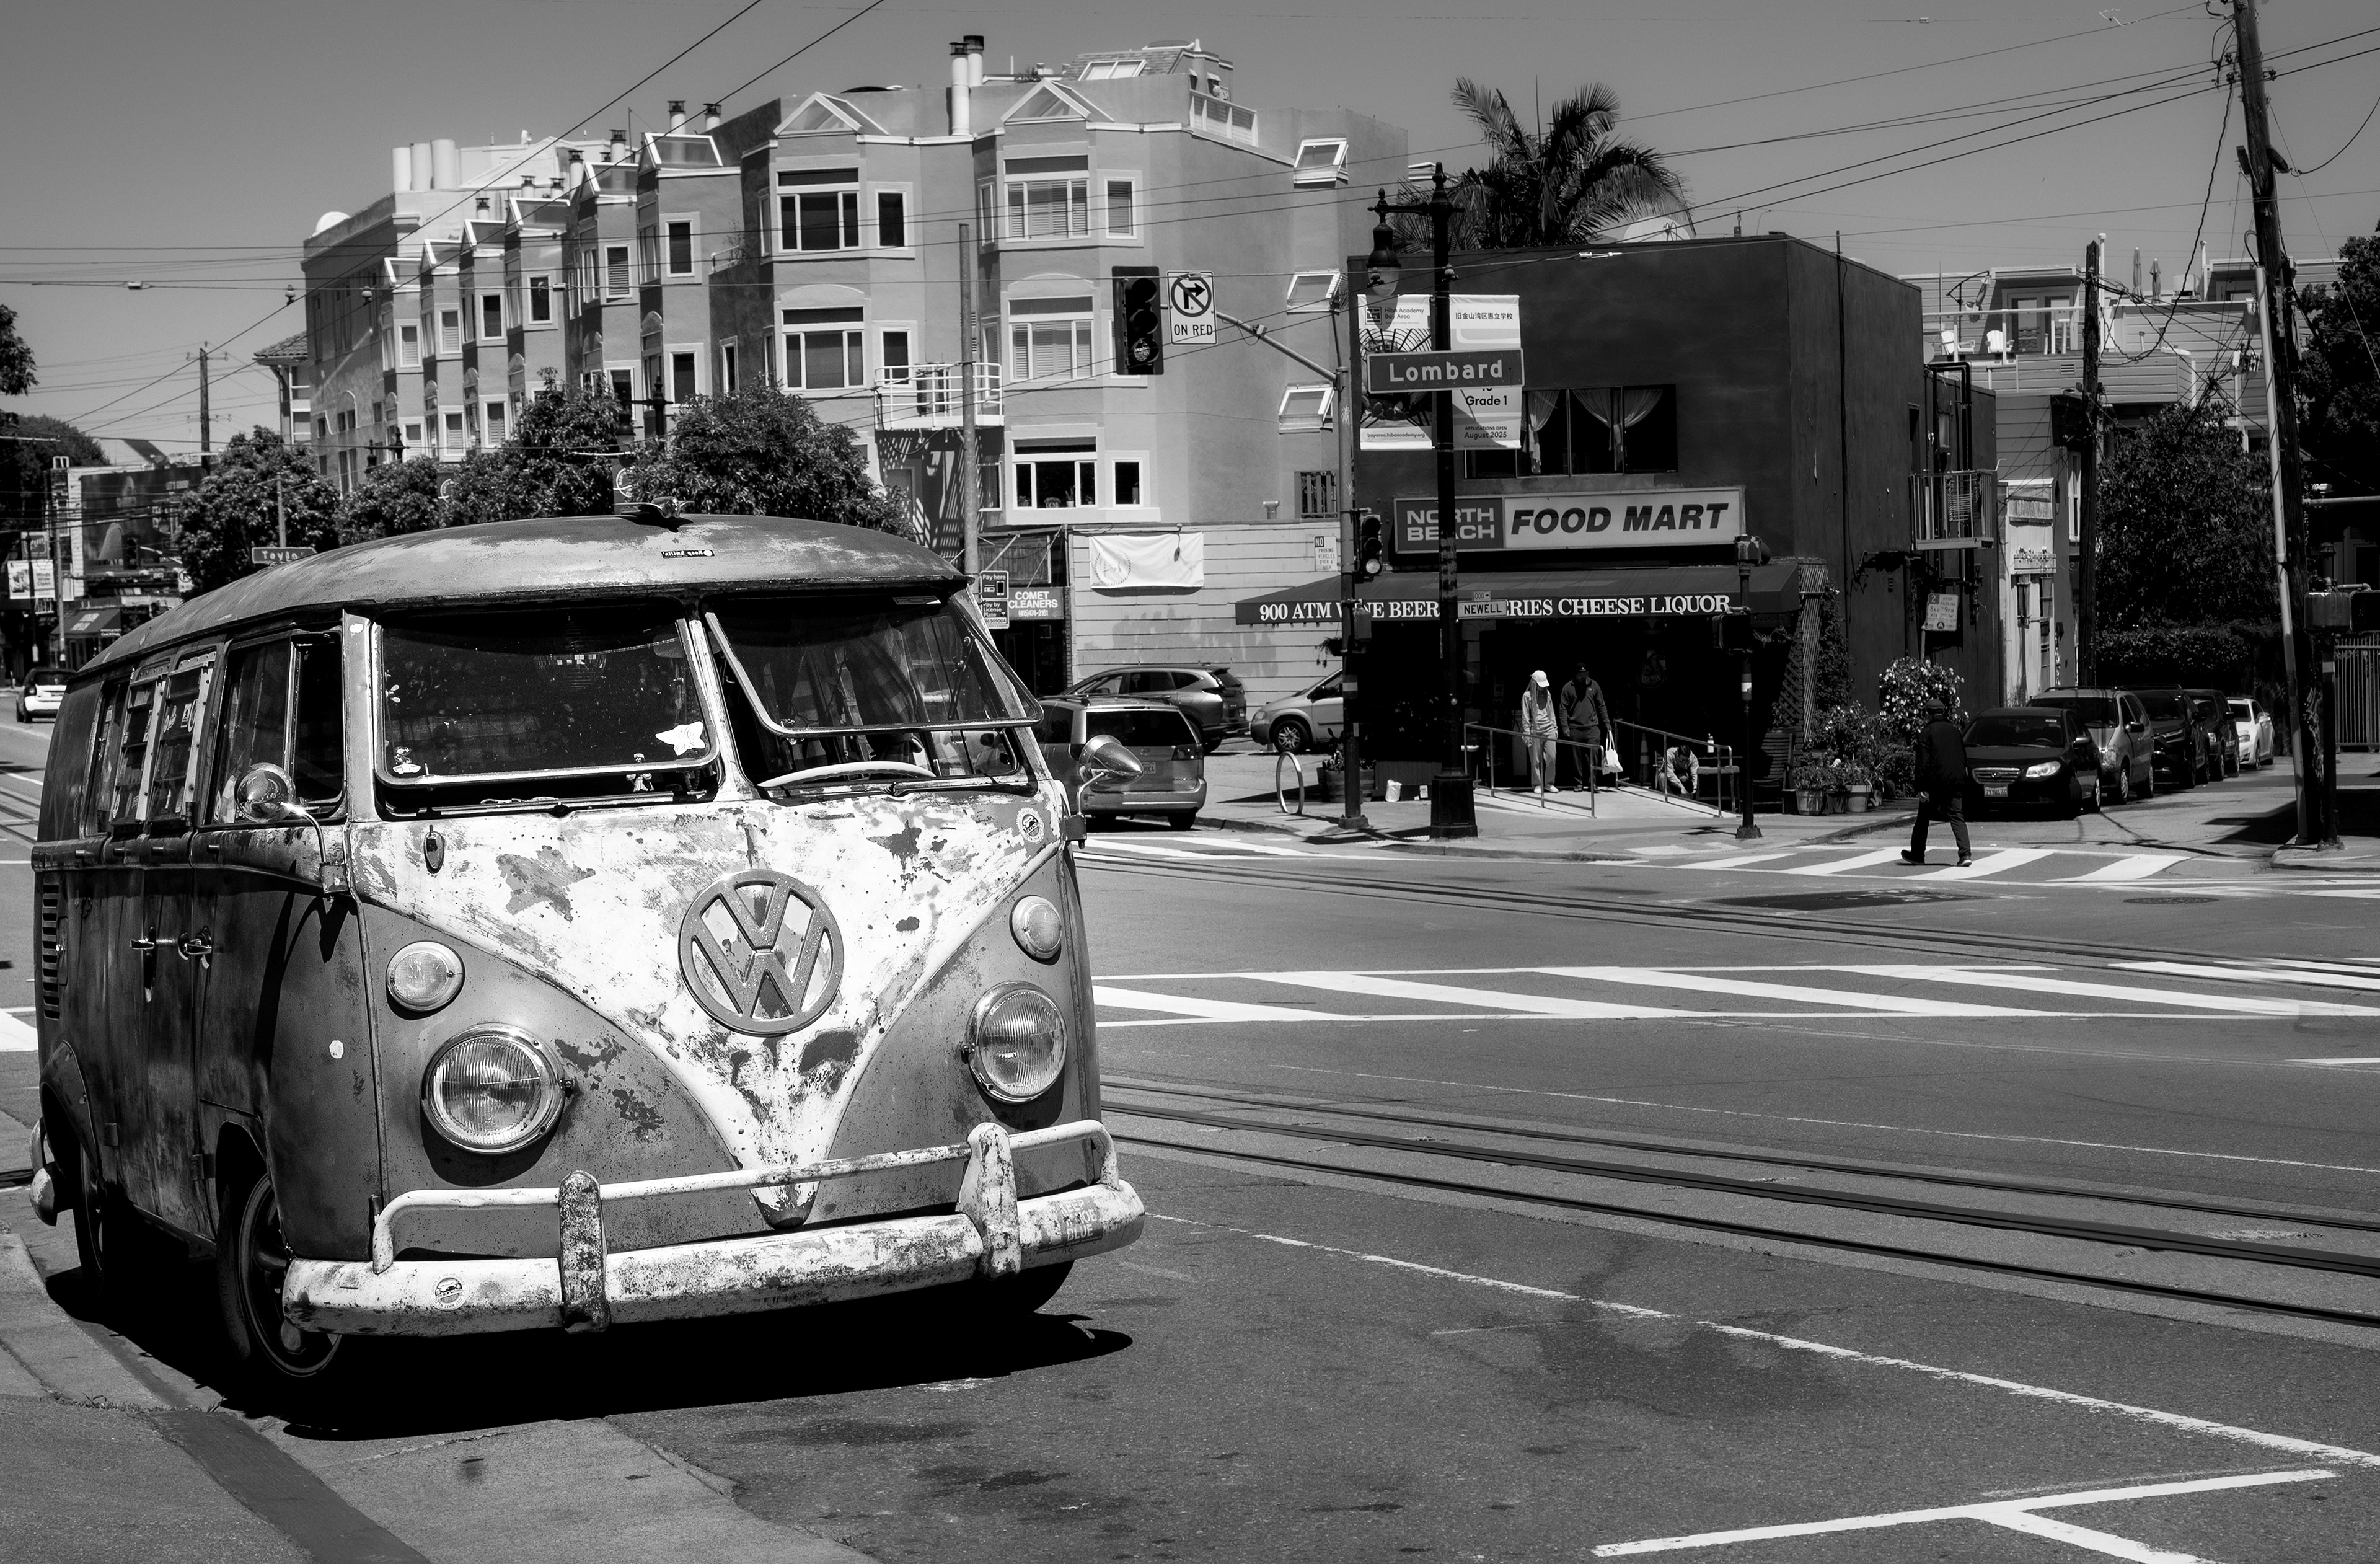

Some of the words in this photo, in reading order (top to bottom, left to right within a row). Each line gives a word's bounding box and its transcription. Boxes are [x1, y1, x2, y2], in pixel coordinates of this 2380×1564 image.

[1174, 324, 1188, 335] ON
[1193, 324, 1213, 335] RED
[1389, 358, 1503, 382] Lombard
[1465, 395, 1501, 406] Grade
[1503, 395, 1507, 405] 1
[1511, 506, 1612, 535] FOOD
[1623, 503, 1729, 532] MART
[1407, 524, 1495, 541] BECH
[1315, 537, 1324, 547] NO
[261, 550, 303, 562] Taylo
[1015, 591, 1050, 601] COMET
[1931, 594, 1936, 603] 2
[1008, 599, 1058, 609] CLEANERS
[1259, 603, 1289, 621] 900
[1292, 602, 1332, 619] ATM
[1388, 601, 1440, 618] BEER
[1558, 597, 1644, 616] CHEESE
[1650, 594, 1730, 615] LIQUOR
[1464, 604, 1502, 614] NEWELL
[1066, 1223, 1093, 1241] BLUE
